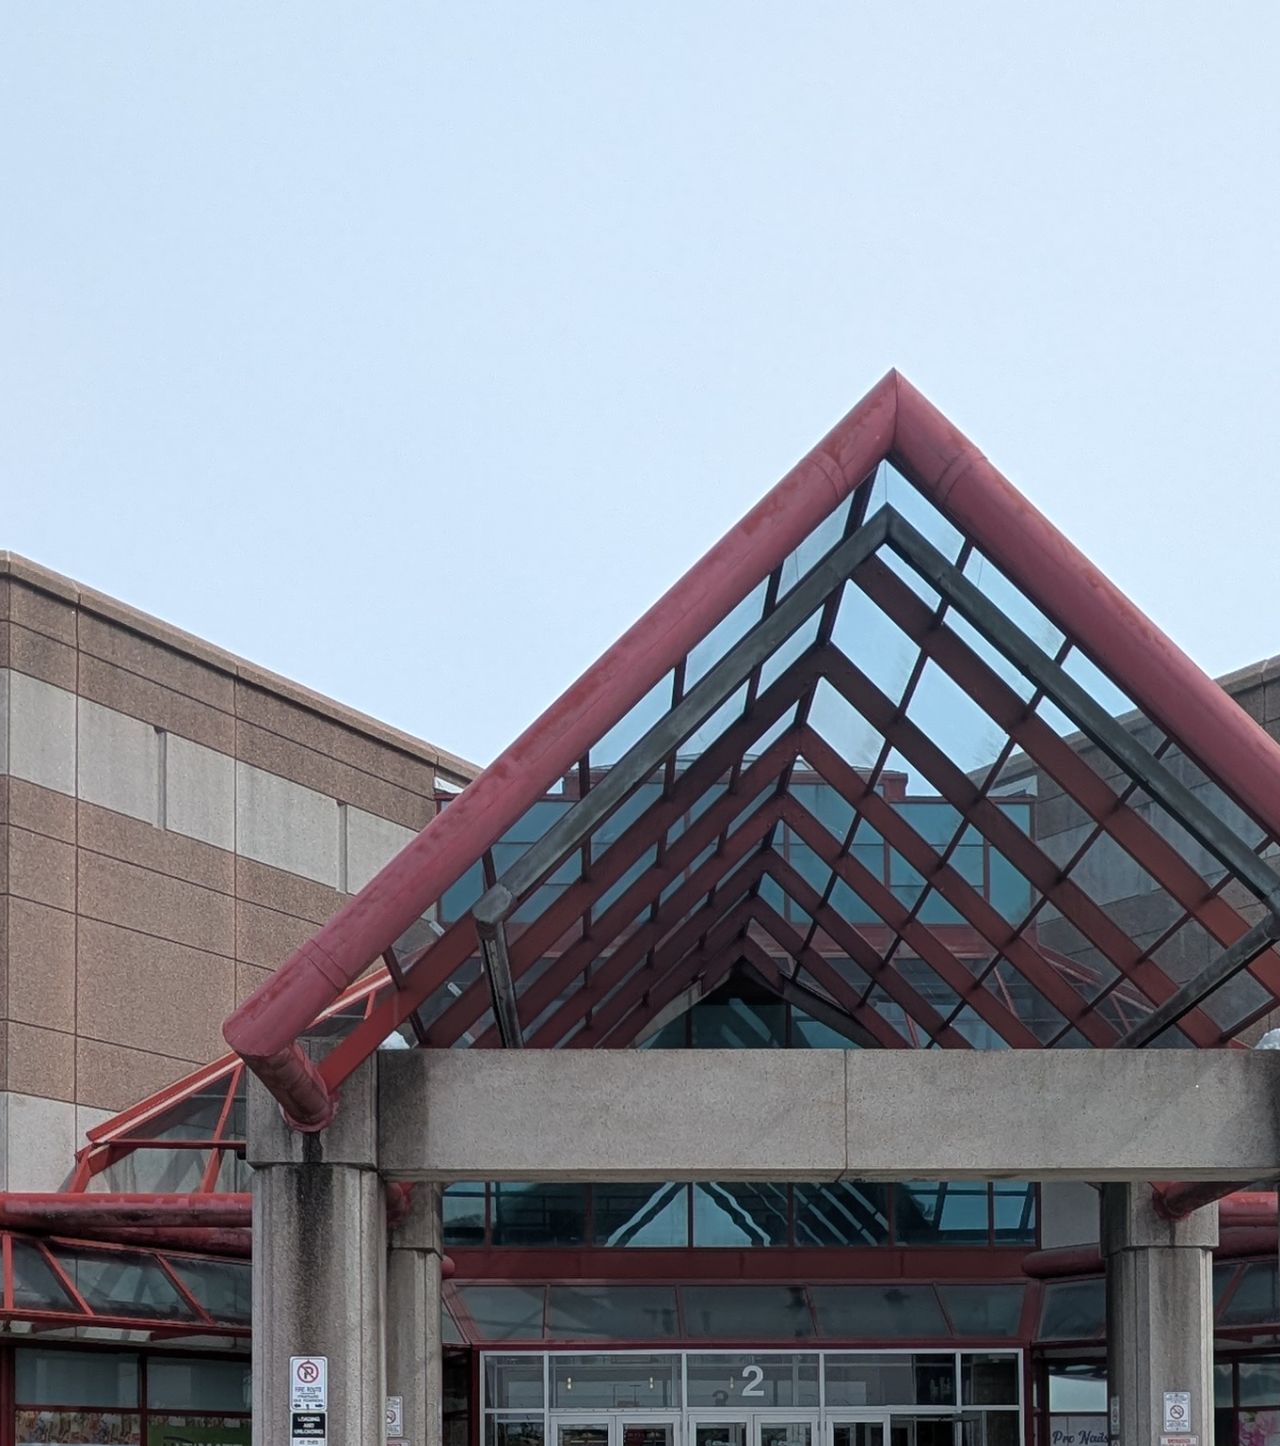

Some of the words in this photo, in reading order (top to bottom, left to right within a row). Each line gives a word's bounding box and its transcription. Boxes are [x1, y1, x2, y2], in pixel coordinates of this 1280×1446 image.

[742, 1365, 764, 1396] 2
[1052, 1430, 1075, 1445] Pro
[1078, 1429, 1109, 1445] Nails
